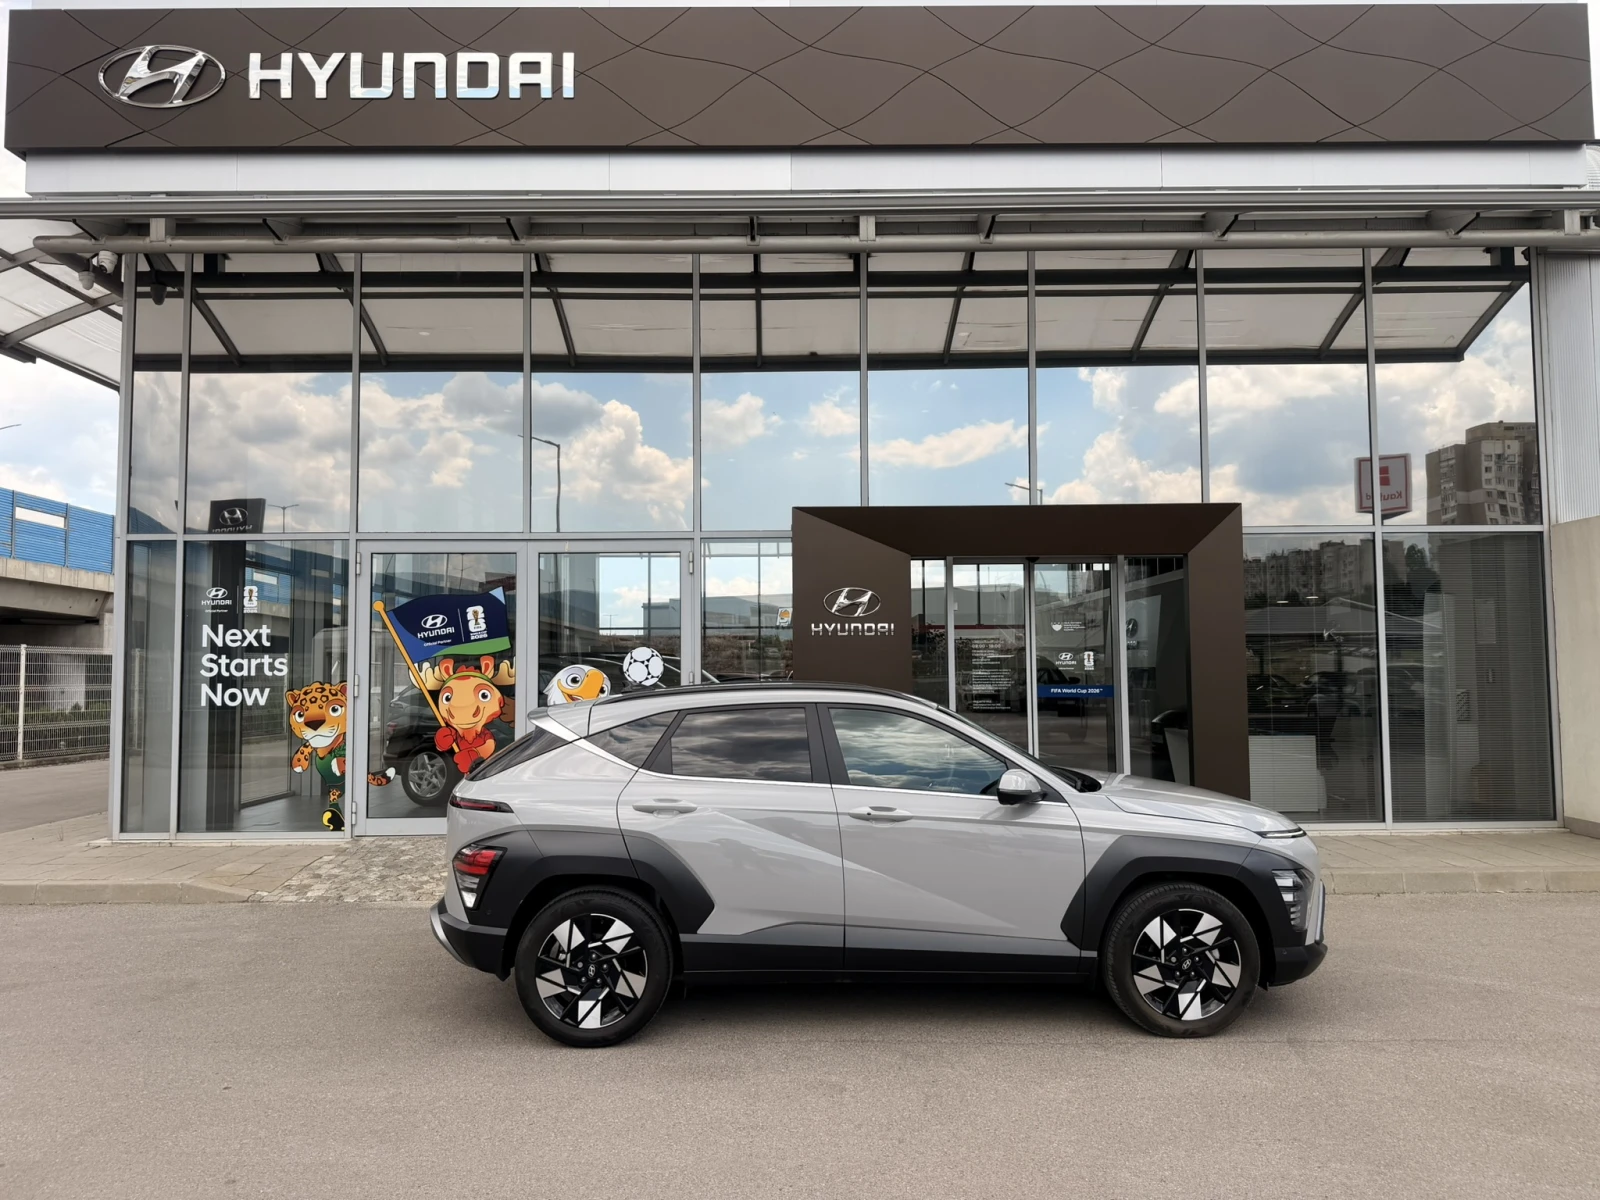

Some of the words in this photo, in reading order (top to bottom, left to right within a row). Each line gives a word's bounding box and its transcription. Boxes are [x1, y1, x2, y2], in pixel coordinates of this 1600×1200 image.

[249, 52, 574, 99] HYUNDAI
[202, 624, 271, 648] Next
[417, 626, 455, 639] HYUNDAI
[811, 623, 894, 636] HYUNDAI
[200, 653, 288, 677] Starts
[200, 683, 270, 707] Now
